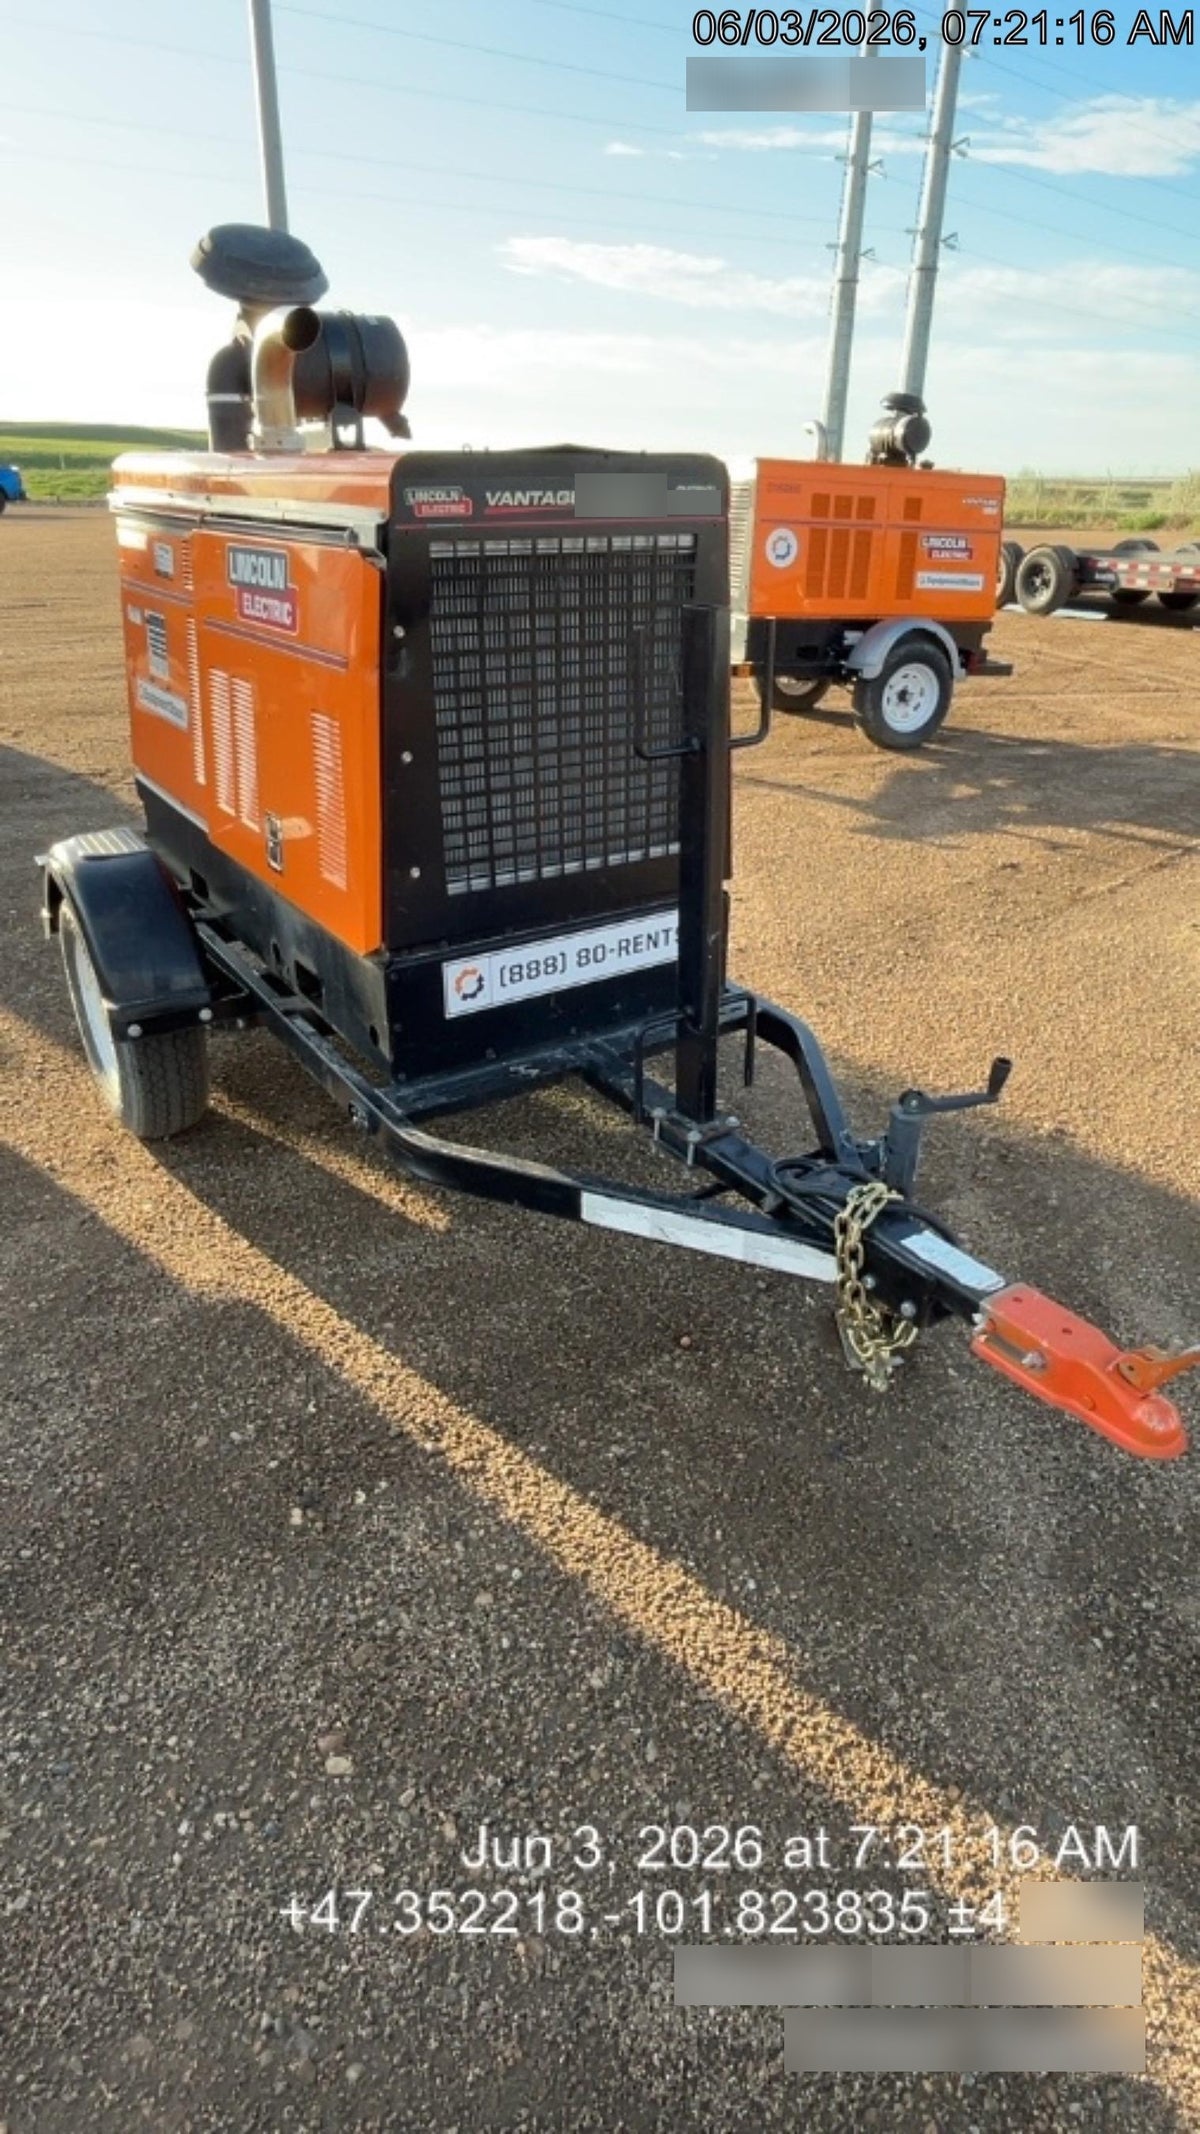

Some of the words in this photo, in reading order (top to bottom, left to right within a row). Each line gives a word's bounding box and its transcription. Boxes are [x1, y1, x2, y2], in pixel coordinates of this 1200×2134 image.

[408, 490, 459, 503] LINCOLN
[229, 551, 286, 591] LINCOLN
[242, 592, 292, 626] ELECTRIC
